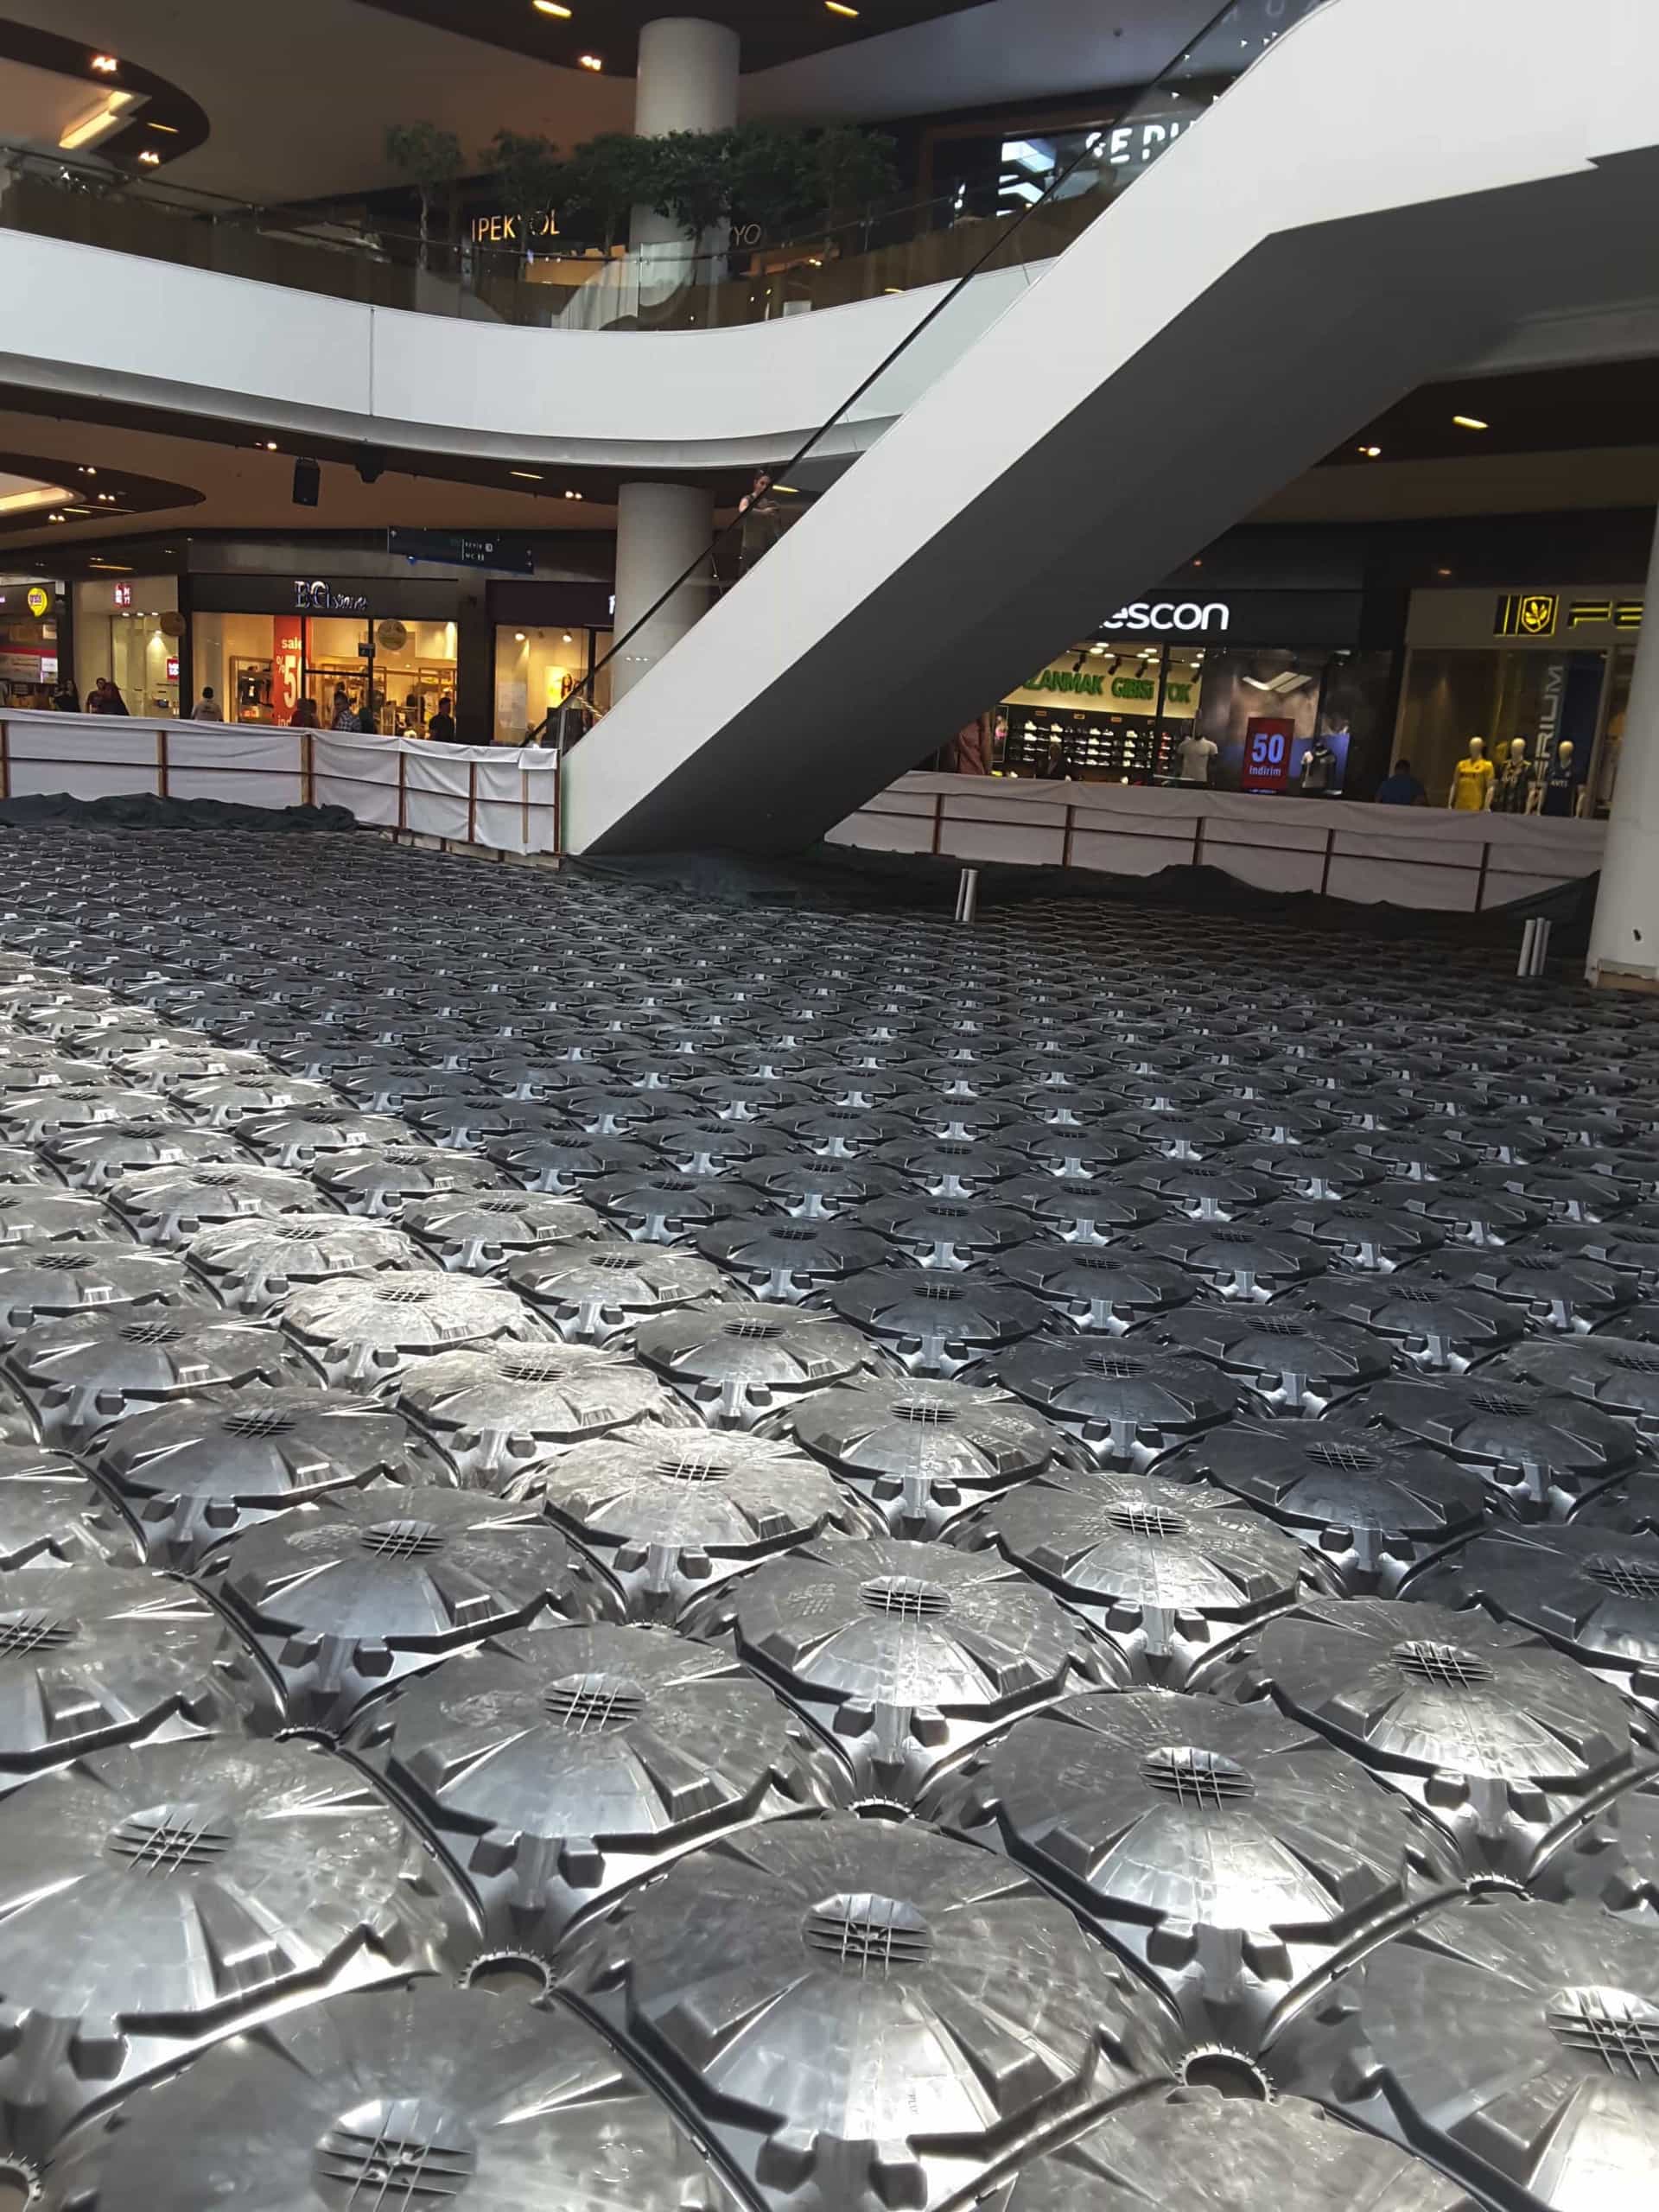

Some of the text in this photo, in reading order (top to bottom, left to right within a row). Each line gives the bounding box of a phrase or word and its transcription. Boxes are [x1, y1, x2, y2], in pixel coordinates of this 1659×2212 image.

[472, 209, 560, 242] IPEKOL
[1099, 602, 1230, 631] escon
[1251, 733, 1285, 764] 50
